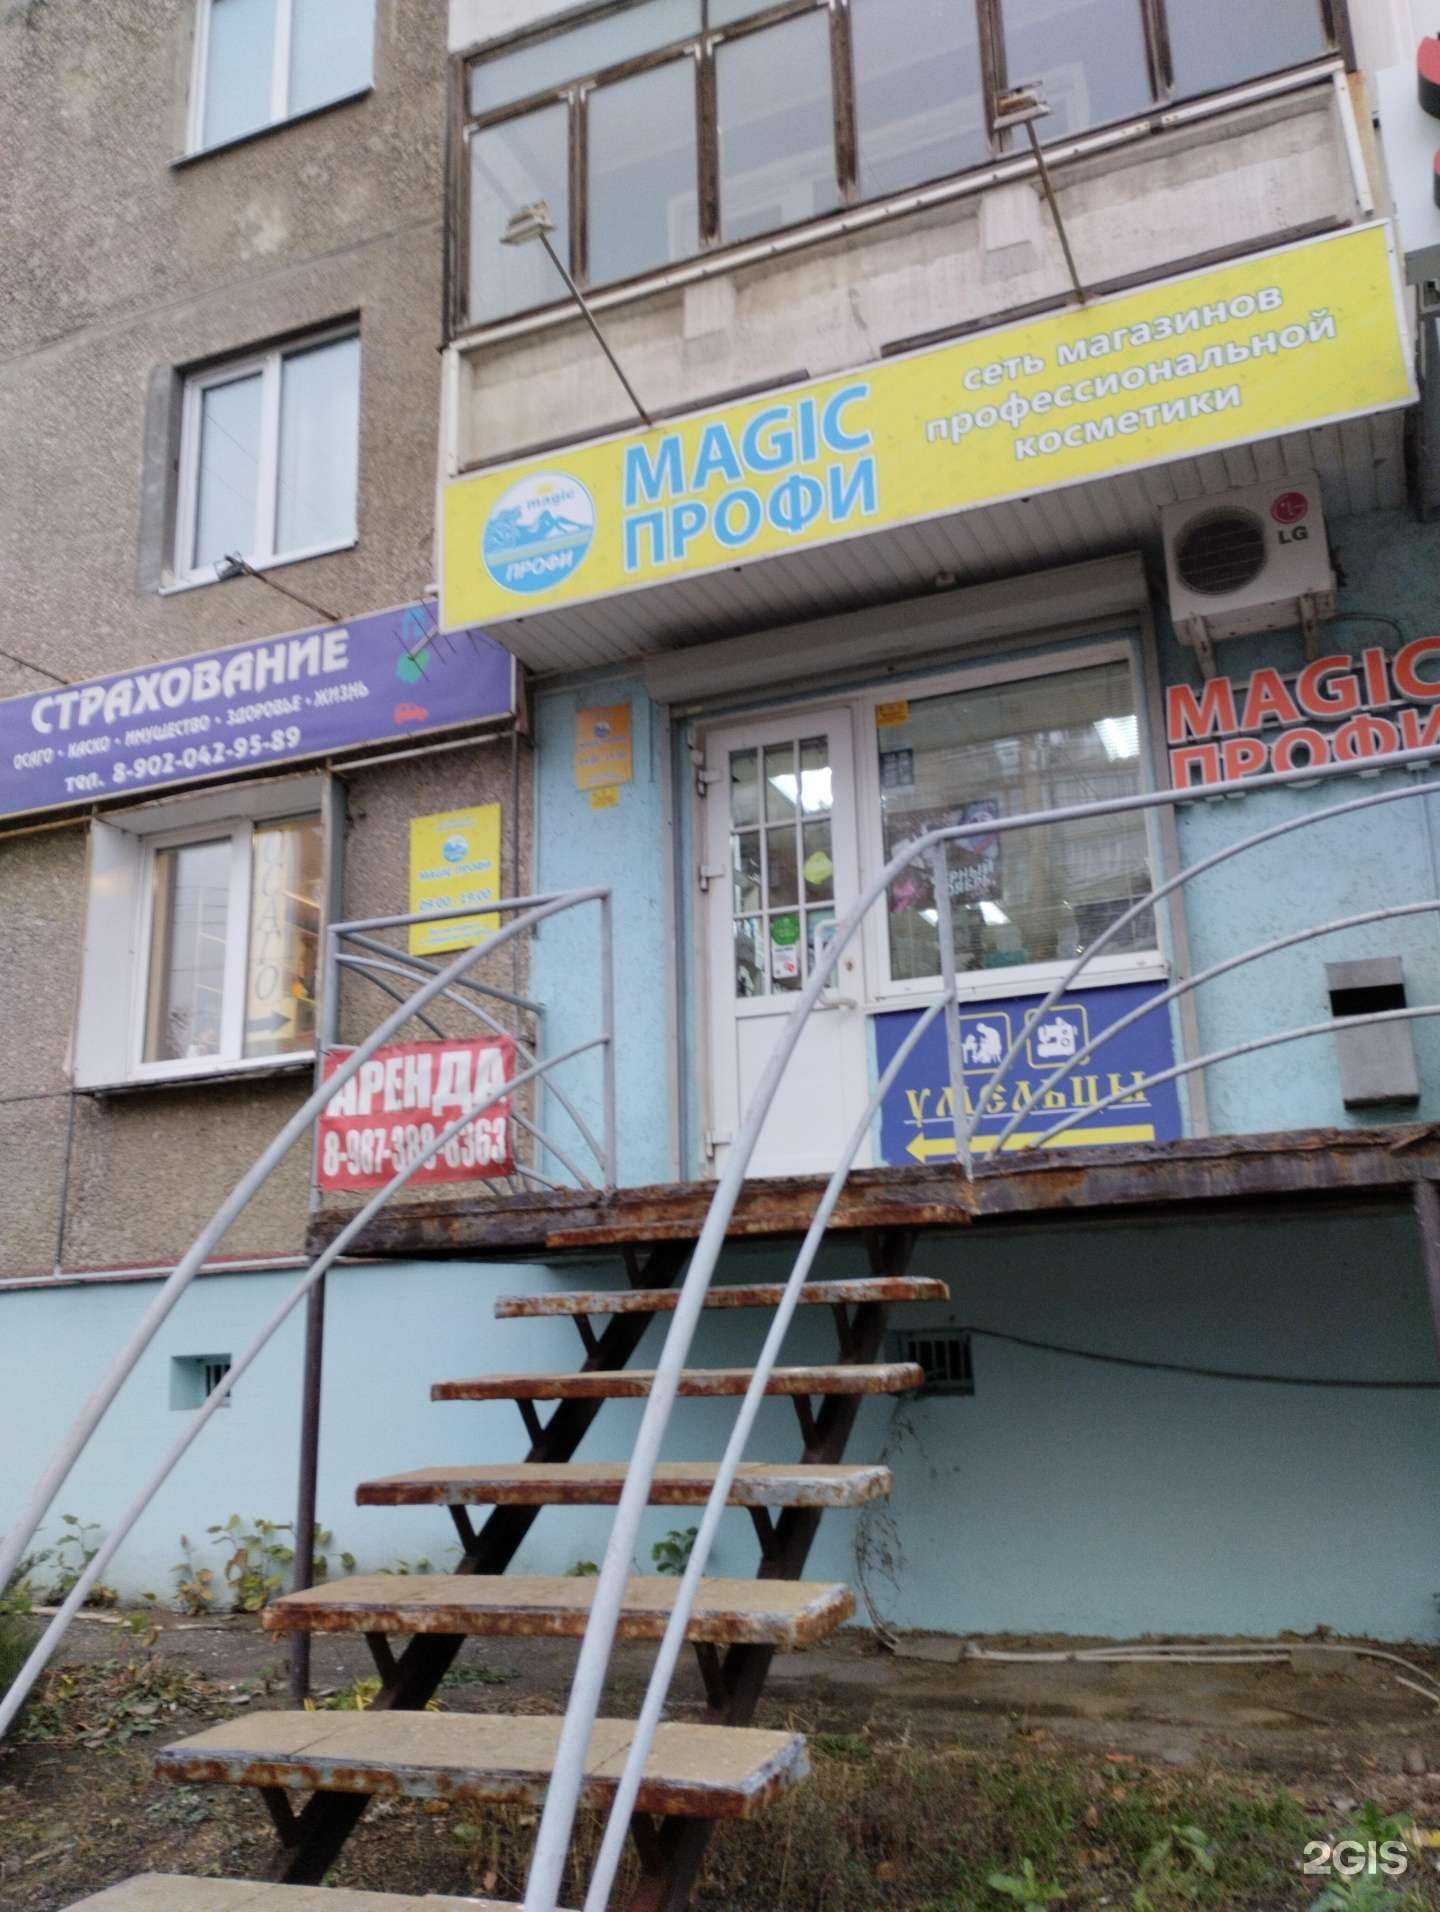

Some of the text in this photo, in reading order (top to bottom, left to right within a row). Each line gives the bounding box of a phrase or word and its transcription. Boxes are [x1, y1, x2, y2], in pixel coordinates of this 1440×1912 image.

[925, 308, 1338, 444] профессиональной
[962, 286, 1283, 394] сеть магазинов
[623, 383, 873, 508] MAGIC
[1014, 384, 1242, 461] косметики
[623, 457, 878, 573] ПРОФИ
[1278, 526, 1309, 544] LG
[505, 549, 574, 582] ПРОФИ
[32, 630, 349, 733] СТРАХОВАНИЕ
[68, 735, 111, 760] КАСКО
[125, 714, 211, 747] ИМУЩЕСТВО
[226, 694, 302, 726] ЗДОРОВЬЕ
[314, 680, 370, 707] ЖИЗНЬ
[1166, 636, 1440, 743] MAGIC
[112, 726, 300, 784] 8-902-042-95-89
[327, 1048, 507, 1118] АРЕНДА
